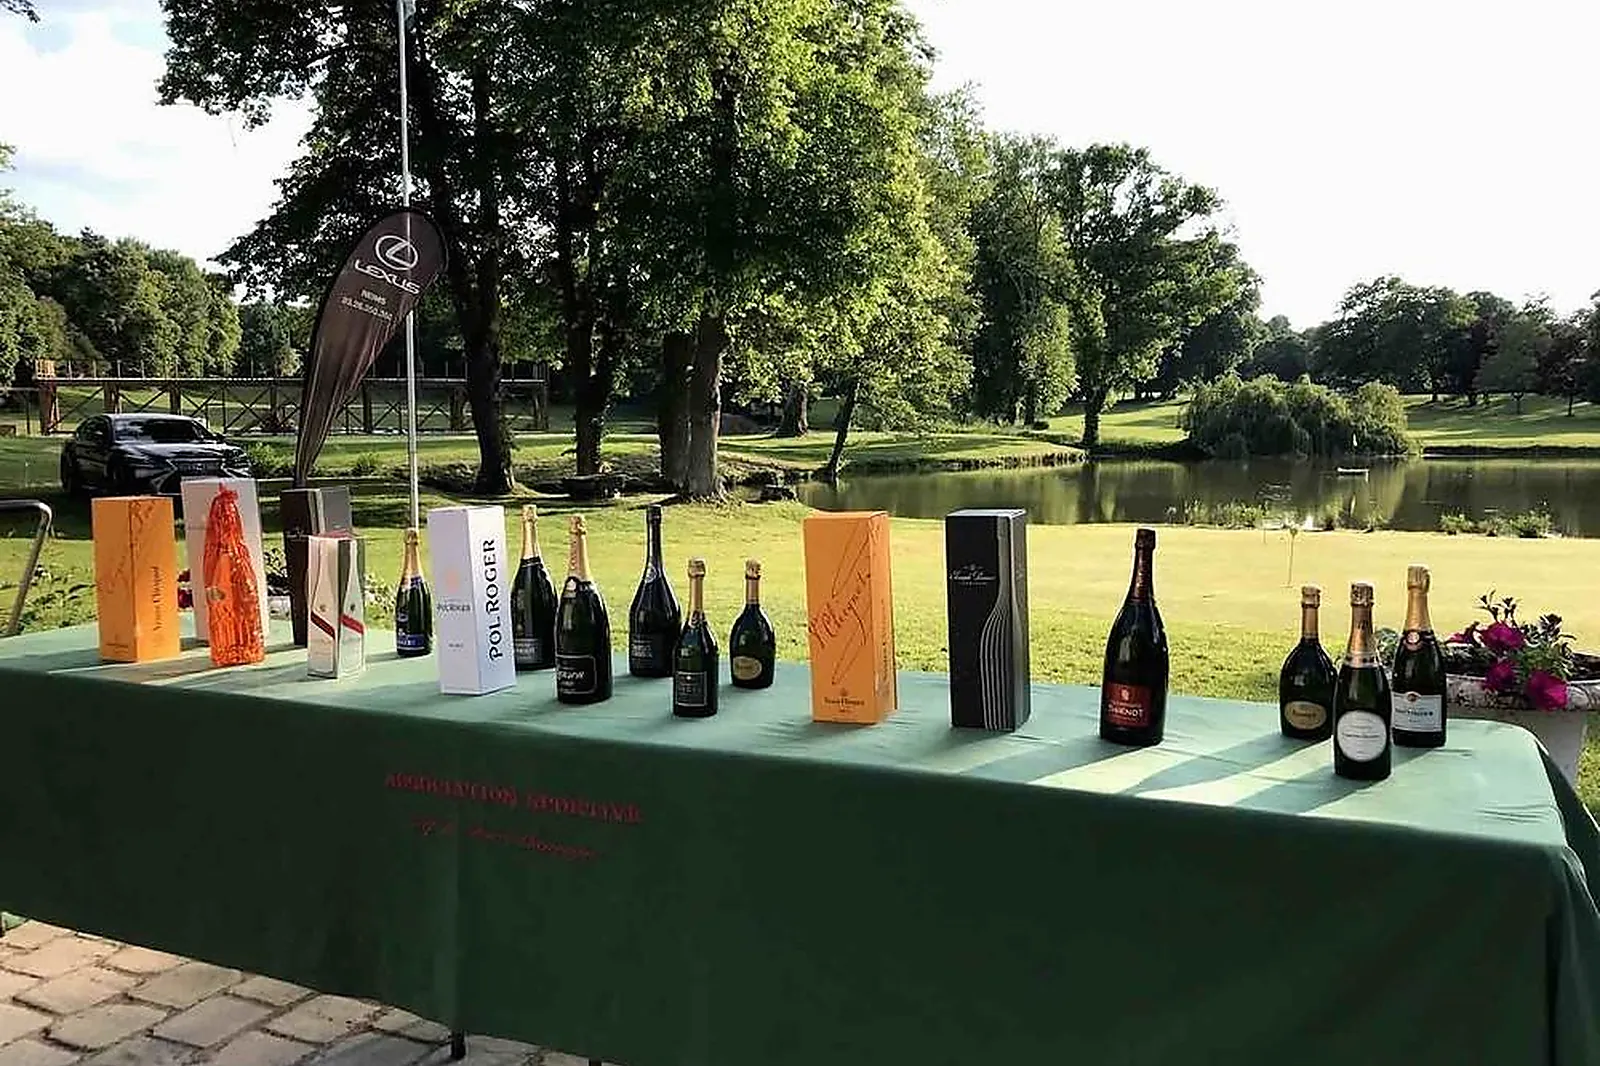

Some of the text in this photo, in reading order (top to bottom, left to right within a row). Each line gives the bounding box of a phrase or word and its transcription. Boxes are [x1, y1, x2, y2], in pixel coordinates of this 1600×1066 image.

[354, 258, 421, 295] LEXUS
[482, 539, 504, 662] POL ROGER
